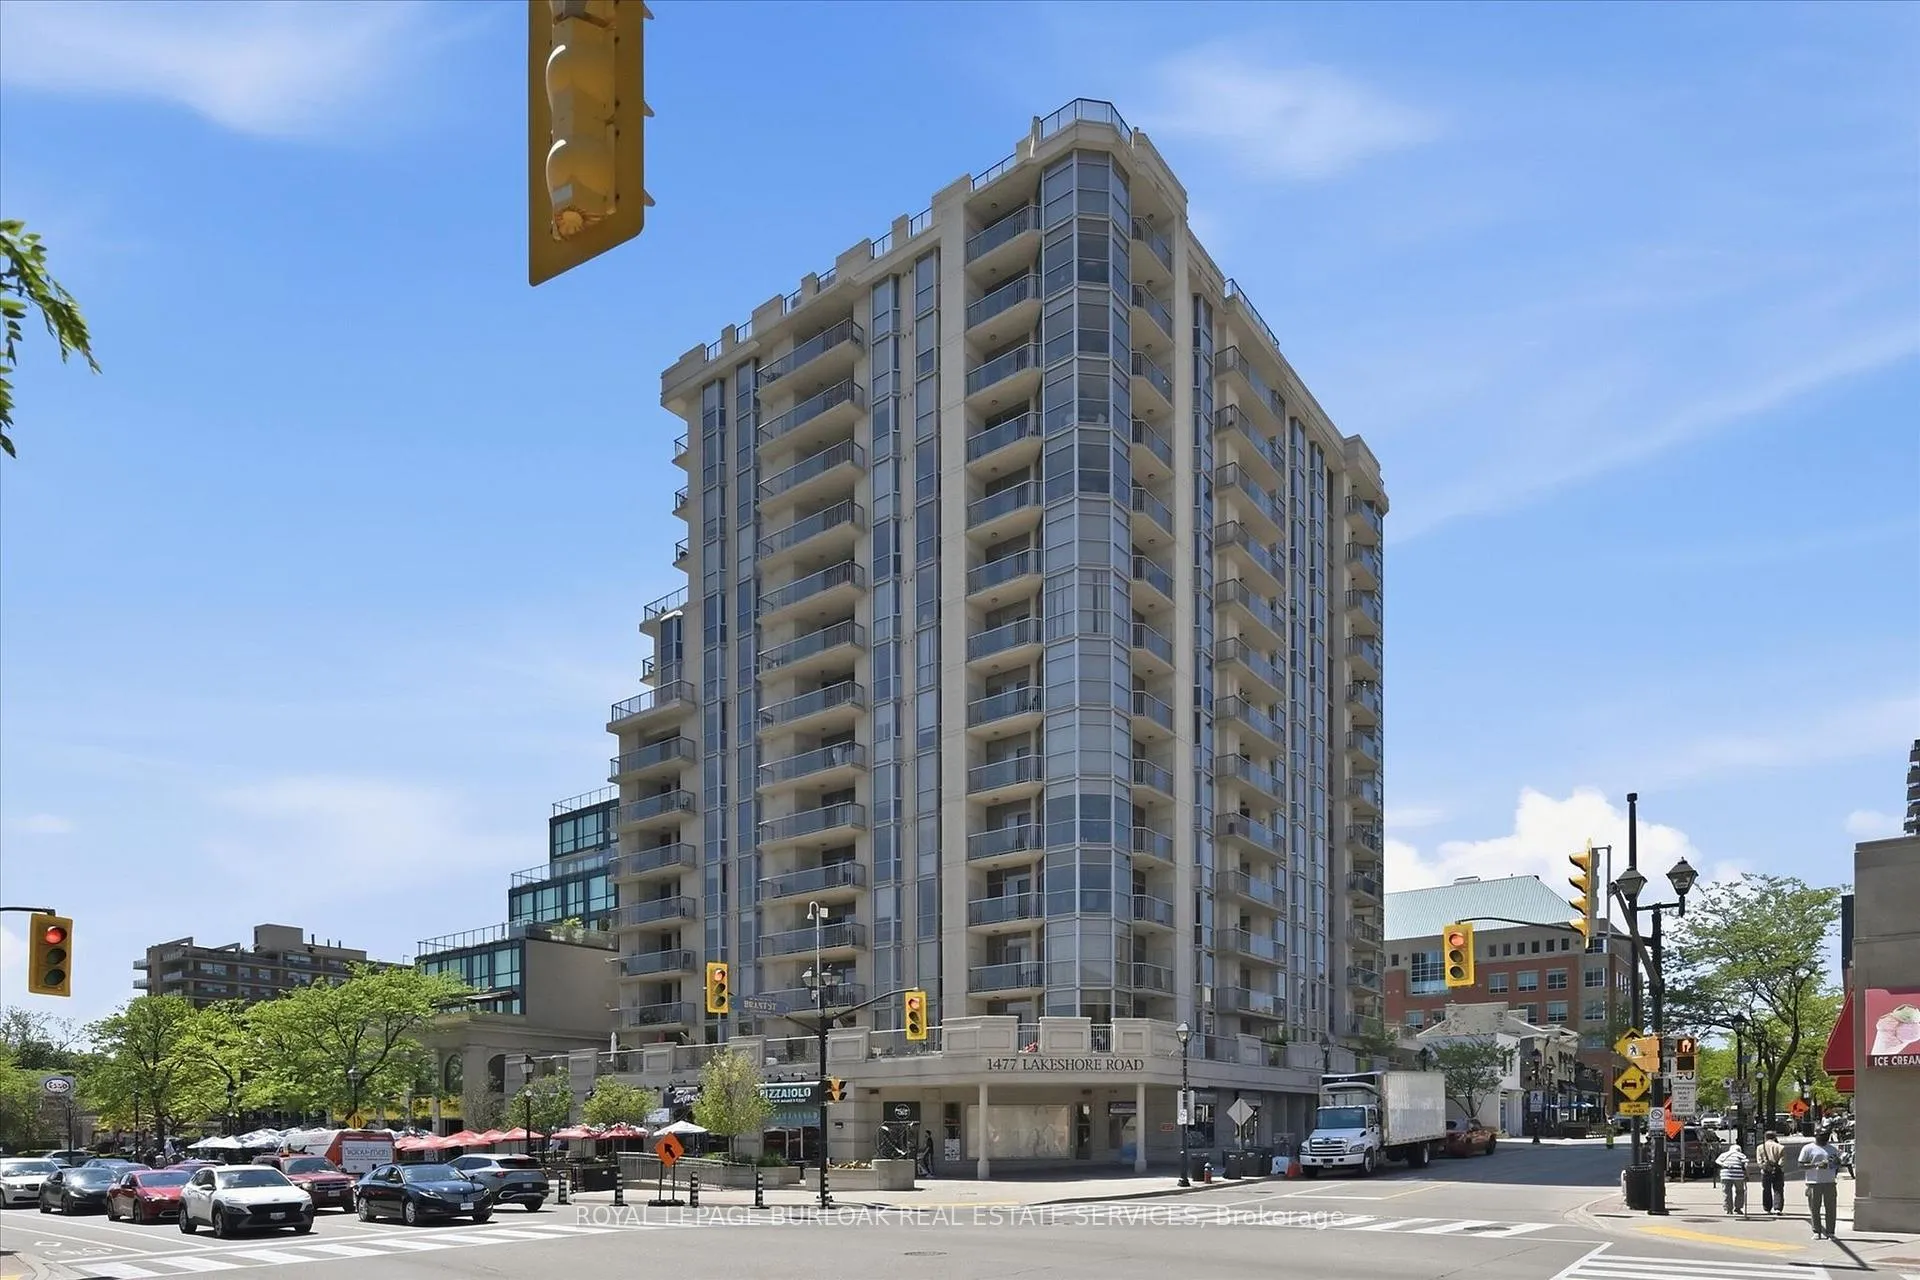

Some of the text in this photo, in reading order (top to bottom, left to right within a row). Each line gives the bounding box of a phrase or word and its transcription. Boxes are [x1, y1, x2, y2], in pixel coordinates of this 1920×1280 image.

[987, 1058, 1145, 1071] 1477 LAKESHORE ROAD
[1874, 1056, 1889, 1066] ICE
[760, 1088, 811, 1098] PIZZAIOLO
